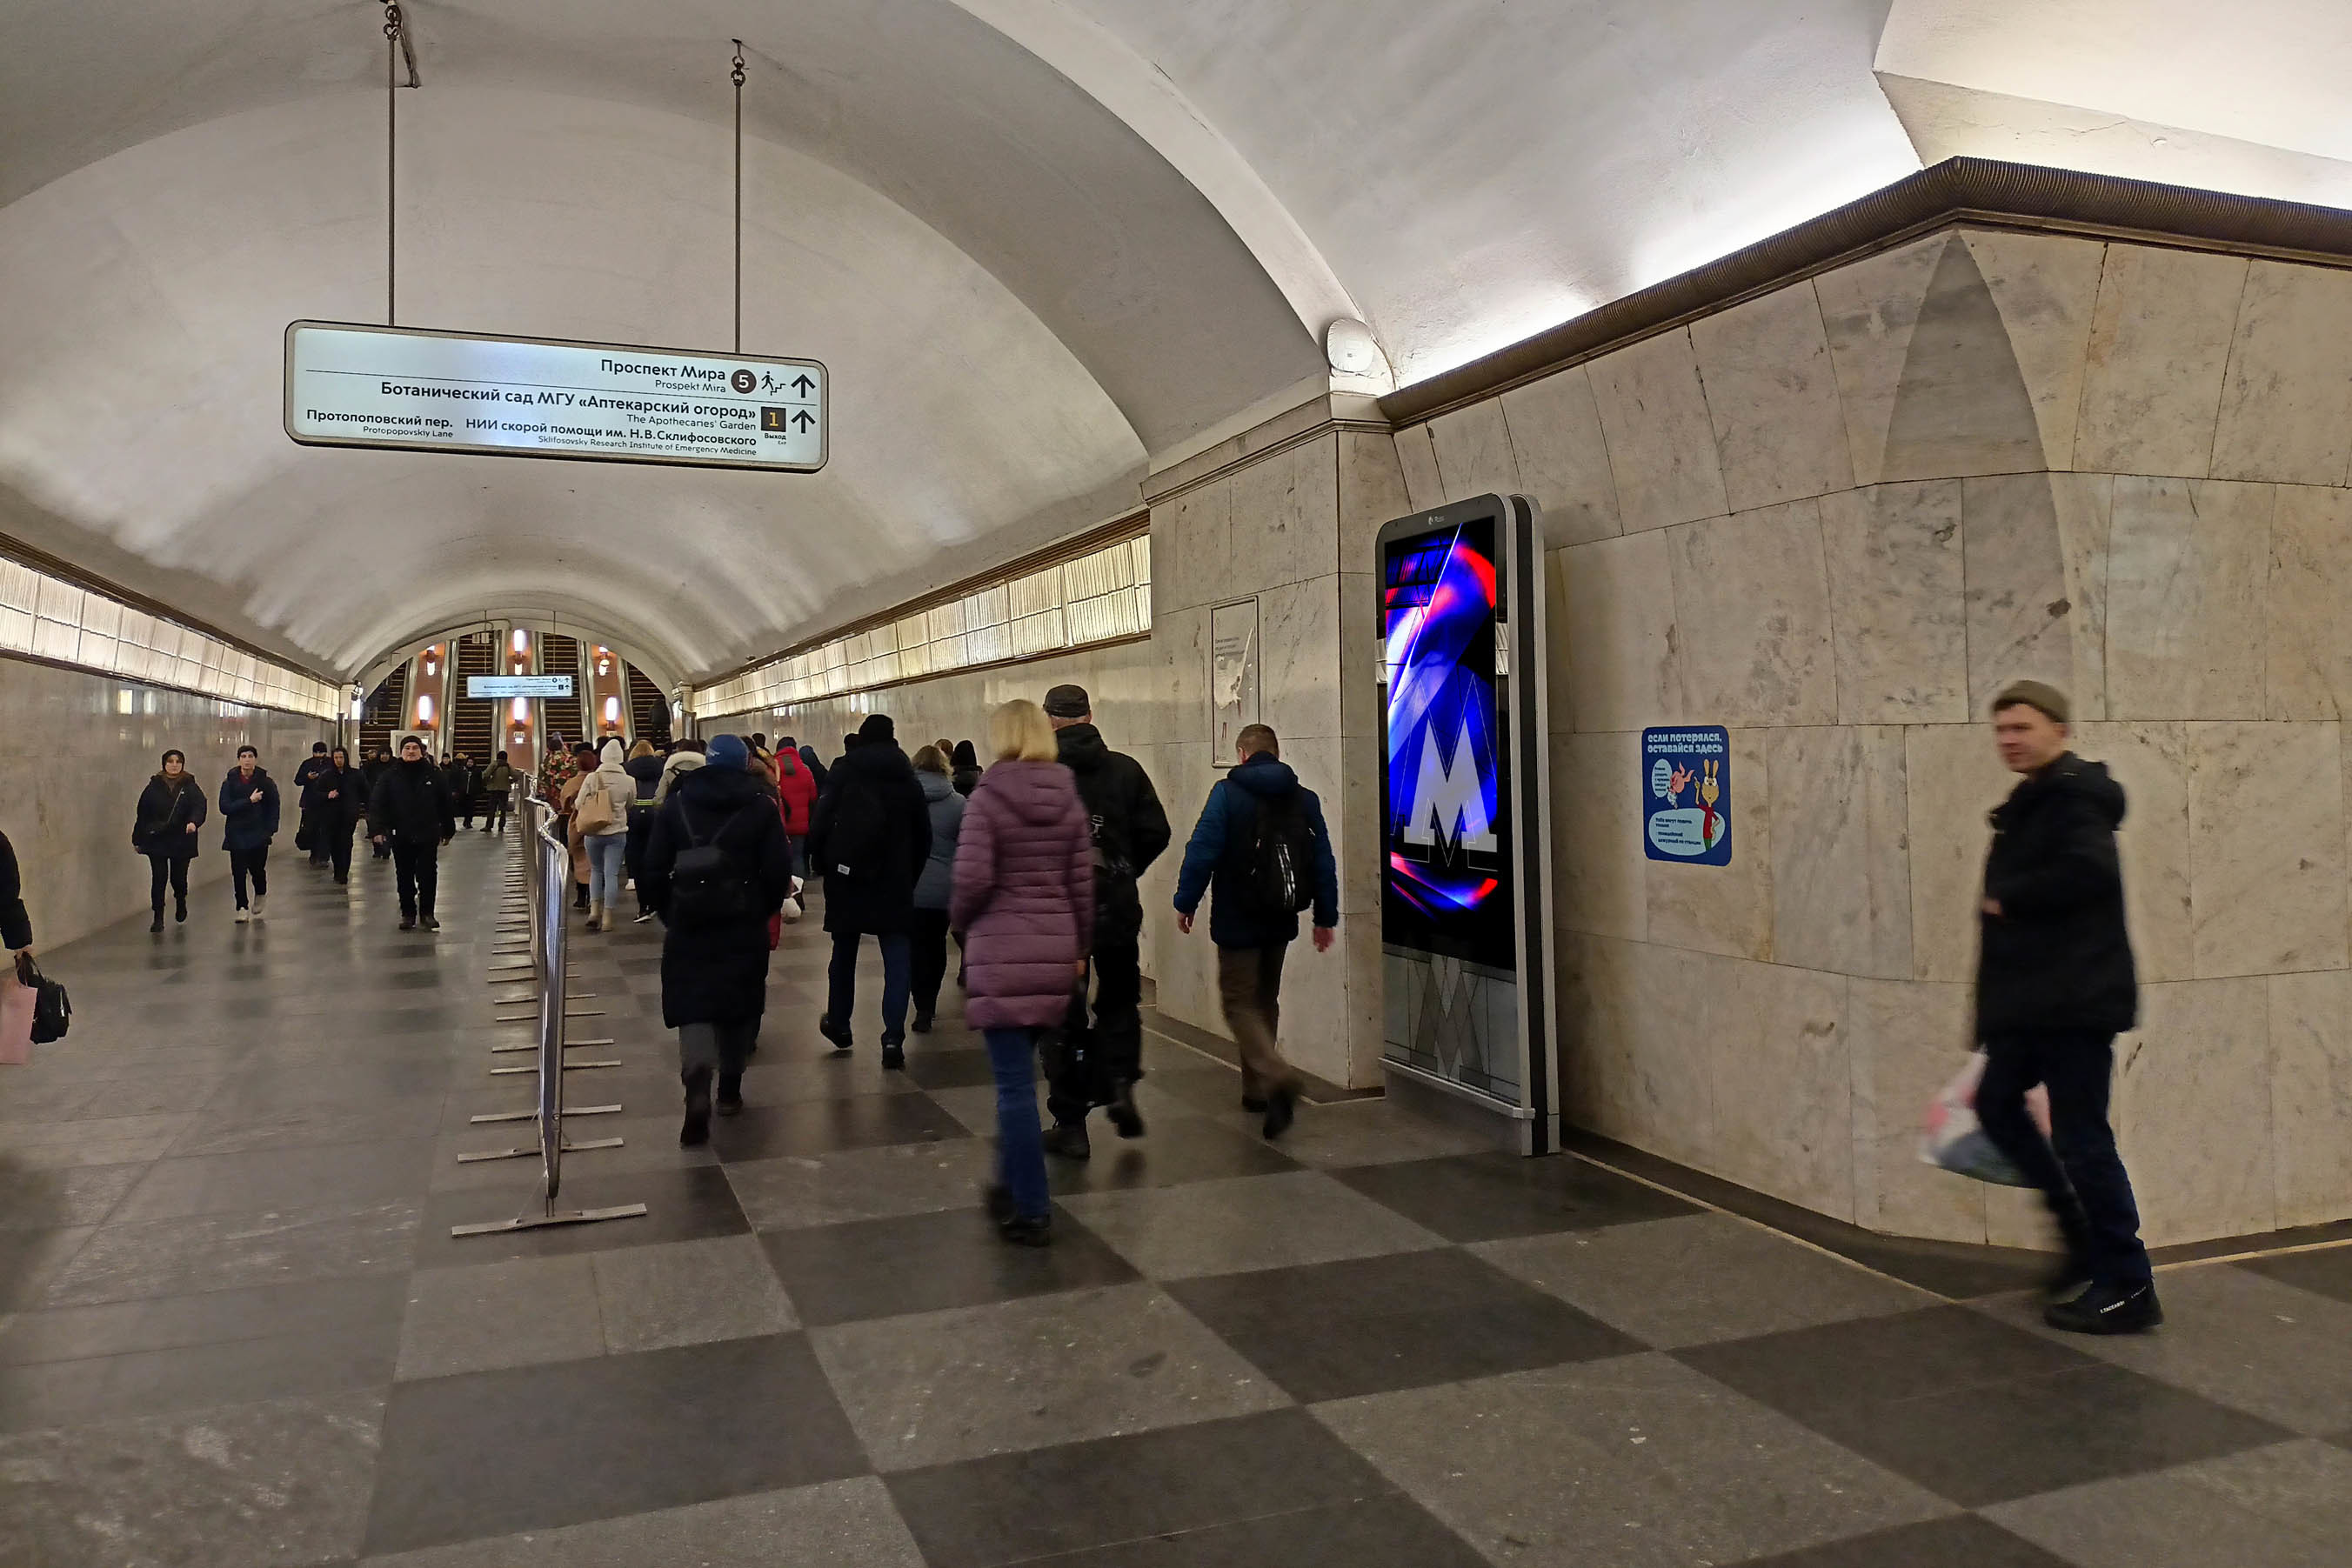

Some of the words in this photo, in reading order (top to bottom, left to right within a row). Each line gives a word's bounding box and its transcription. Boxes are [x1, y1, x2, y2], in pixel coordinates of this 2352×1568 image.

[601, 359, 678, 377] Проспект
[680, 365, 726, 382] Мира
[738, 375, 749, 389] 5
[655, 379, 699, 391] Prospekt
[702, 383, 726, 393] Mira
[381, 381, 500, 402] Ботанический
[504, 391, 534, 405] сад
[537, 391, 576, 406] МГУ
[578, 395, 690, 414] «Аптекарский
[693, 404, 756, 420] огород»
[306, 409, 422, 426] Протопоповский
[424, 417, 453, 429] пер.
[466, 418, 498, 430] НИИ
[501, 422, 547, 434] скорой
[551, 424, 603, 437] помощи
[605, 429, 626, 438] им.
[626, 414, 646, 424] The
[719, 420, 757, 430] Garden
[768, 411, 779, 427] 1
[363, 425, 431, 437] Protopopovskiy
[432, 430, 453, 438] Lane
[538, 435, 589, 446] Sklifosovsky
[590, 438, 627, 448] Research
[629, 440, 664, 450] Institute
[675, 444, 718, 454] Emergency
[719, 447, 757, 456] Medicine
